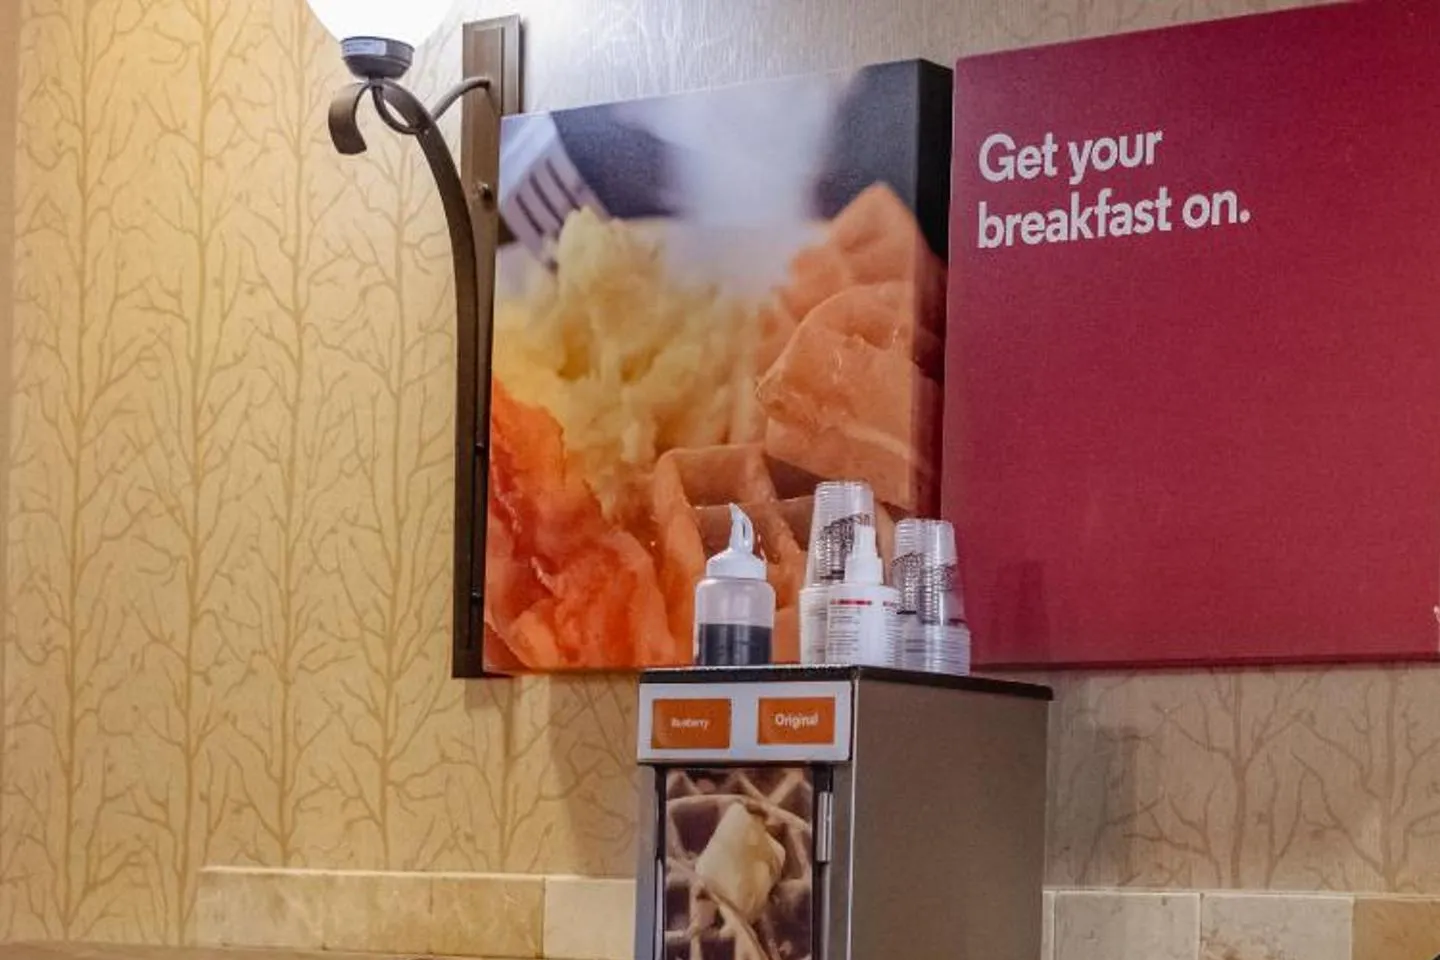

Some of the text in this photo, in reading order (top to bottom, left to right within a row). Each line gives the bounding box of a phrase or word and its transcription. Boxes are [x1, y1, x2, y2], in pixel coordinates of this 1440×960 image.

[978, 130, 1164, 185] Get your
[976, 186, 1251, 249] breakfast on.
[775, 712, 819, 730] Original
